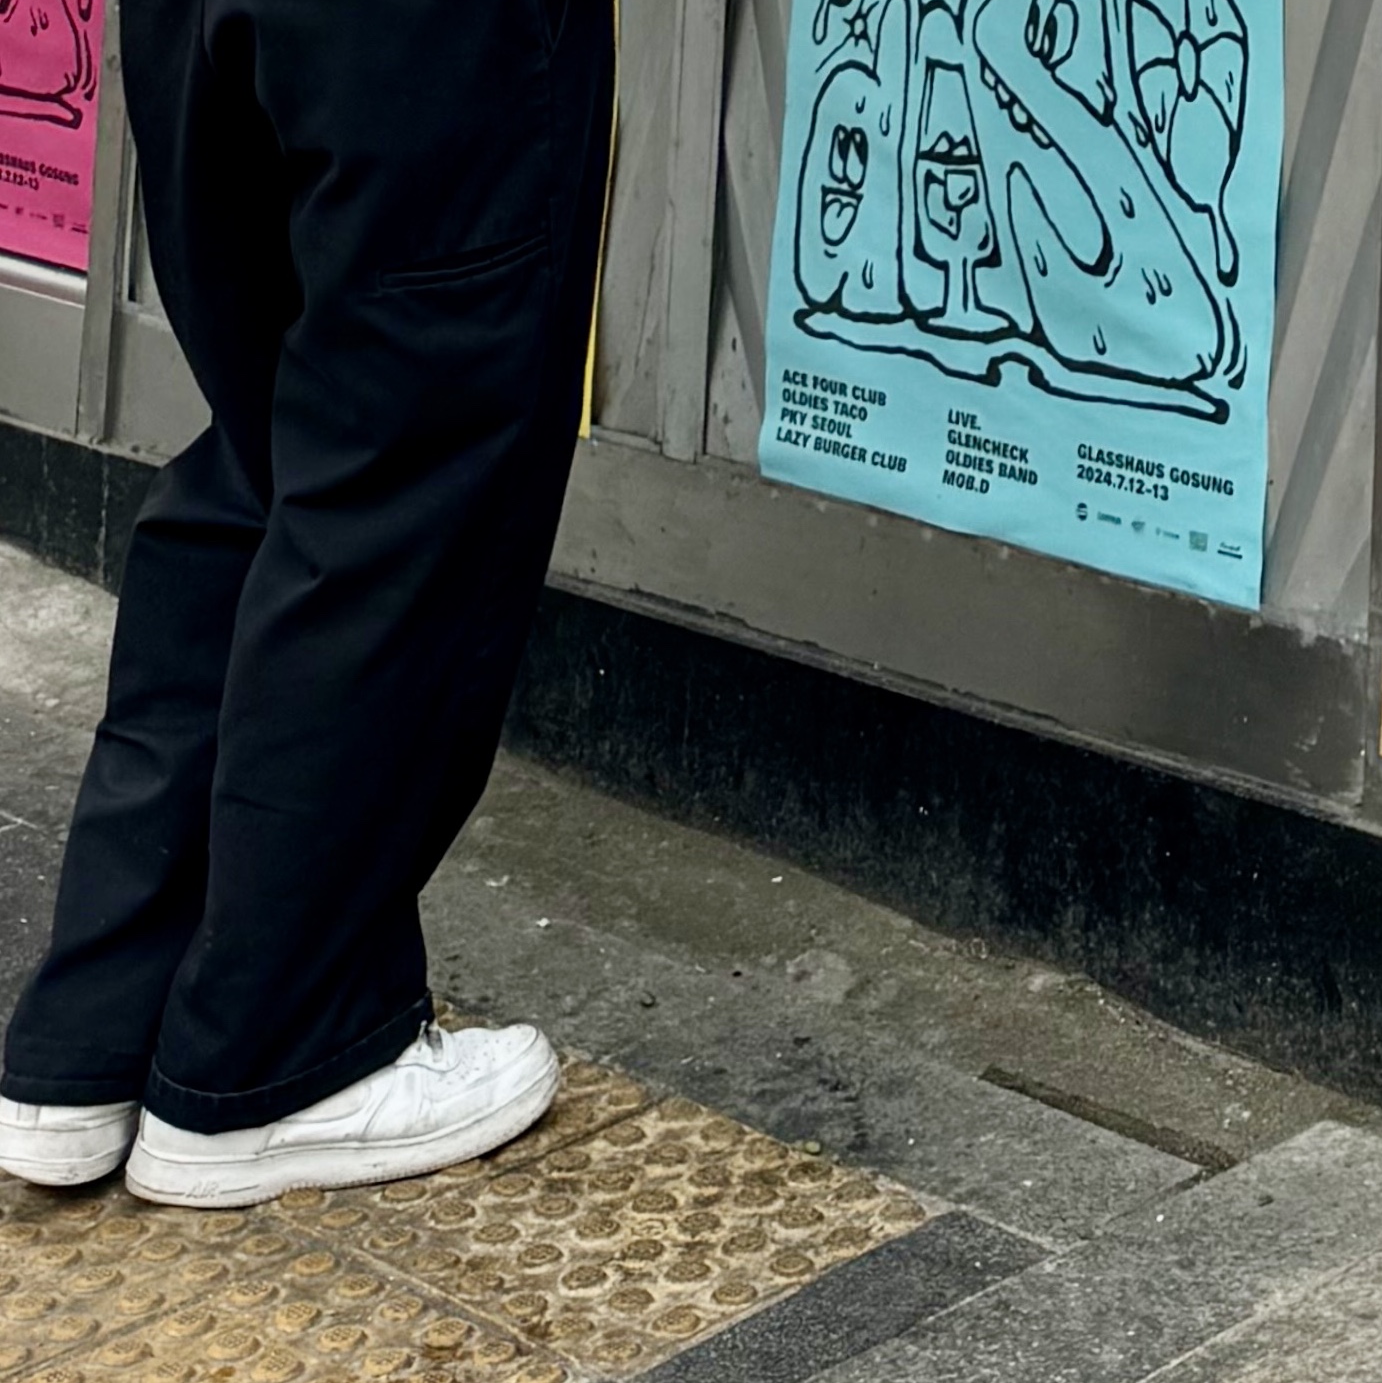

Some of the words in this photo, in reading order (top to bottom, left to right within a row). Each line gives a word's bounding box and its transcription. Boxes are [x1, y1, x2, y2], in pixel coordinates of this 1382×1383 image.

[781, 388, 830, 414] OLDIES
[832, 398, 868, 422] TACO
[782, 369, 808, 389] ACE
[811, 377, 848, 400] FOUR
[851, 385, 887, 406] CLUB
[780, 407, 807, 429] PKY
[810, 414, 853, 439] SEOUL
[775, 427, 810, 448] LAZY
[813, 436, 868, 464] BURGER
[870, 448, 907, 473] CLUB
[946, 429, 1029, 464] GLENCHECK
[942, 469, 991, 496] MOB.D
[945, 450, 995, 477] OLDIES
[998, 462, 1038, 487] BAND
[1076, 442, 1166, 480] GLASSHAUS
[1169, 462, 1235, 497] GOSUNG
[1076, 464, 1170, 502] 2024.7.12-13
